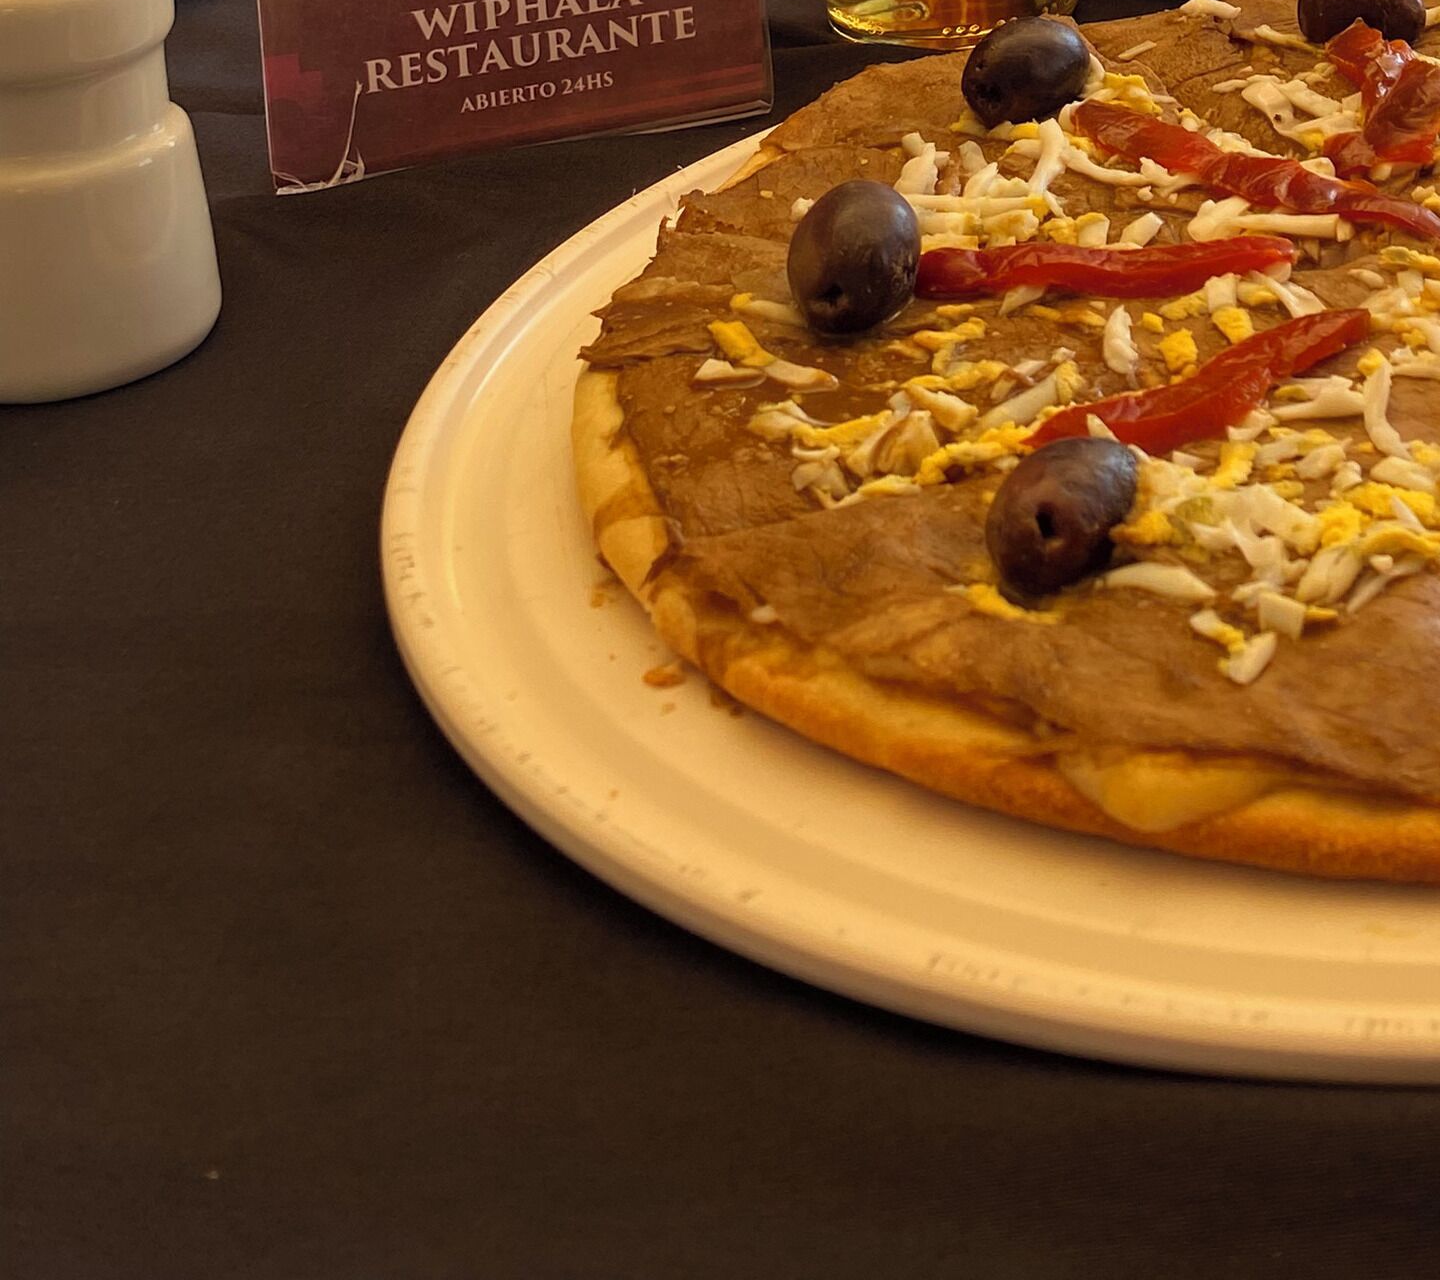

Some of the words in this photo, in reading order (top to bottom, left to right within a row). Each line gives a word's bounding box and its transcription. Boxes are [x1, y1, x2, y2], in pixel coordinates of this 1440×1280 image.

[364, 6, 697, 94] RESTAURANTE
[460, 81, 557, 114] ABIERTO
[562, 71, 614, 95] 24HS
